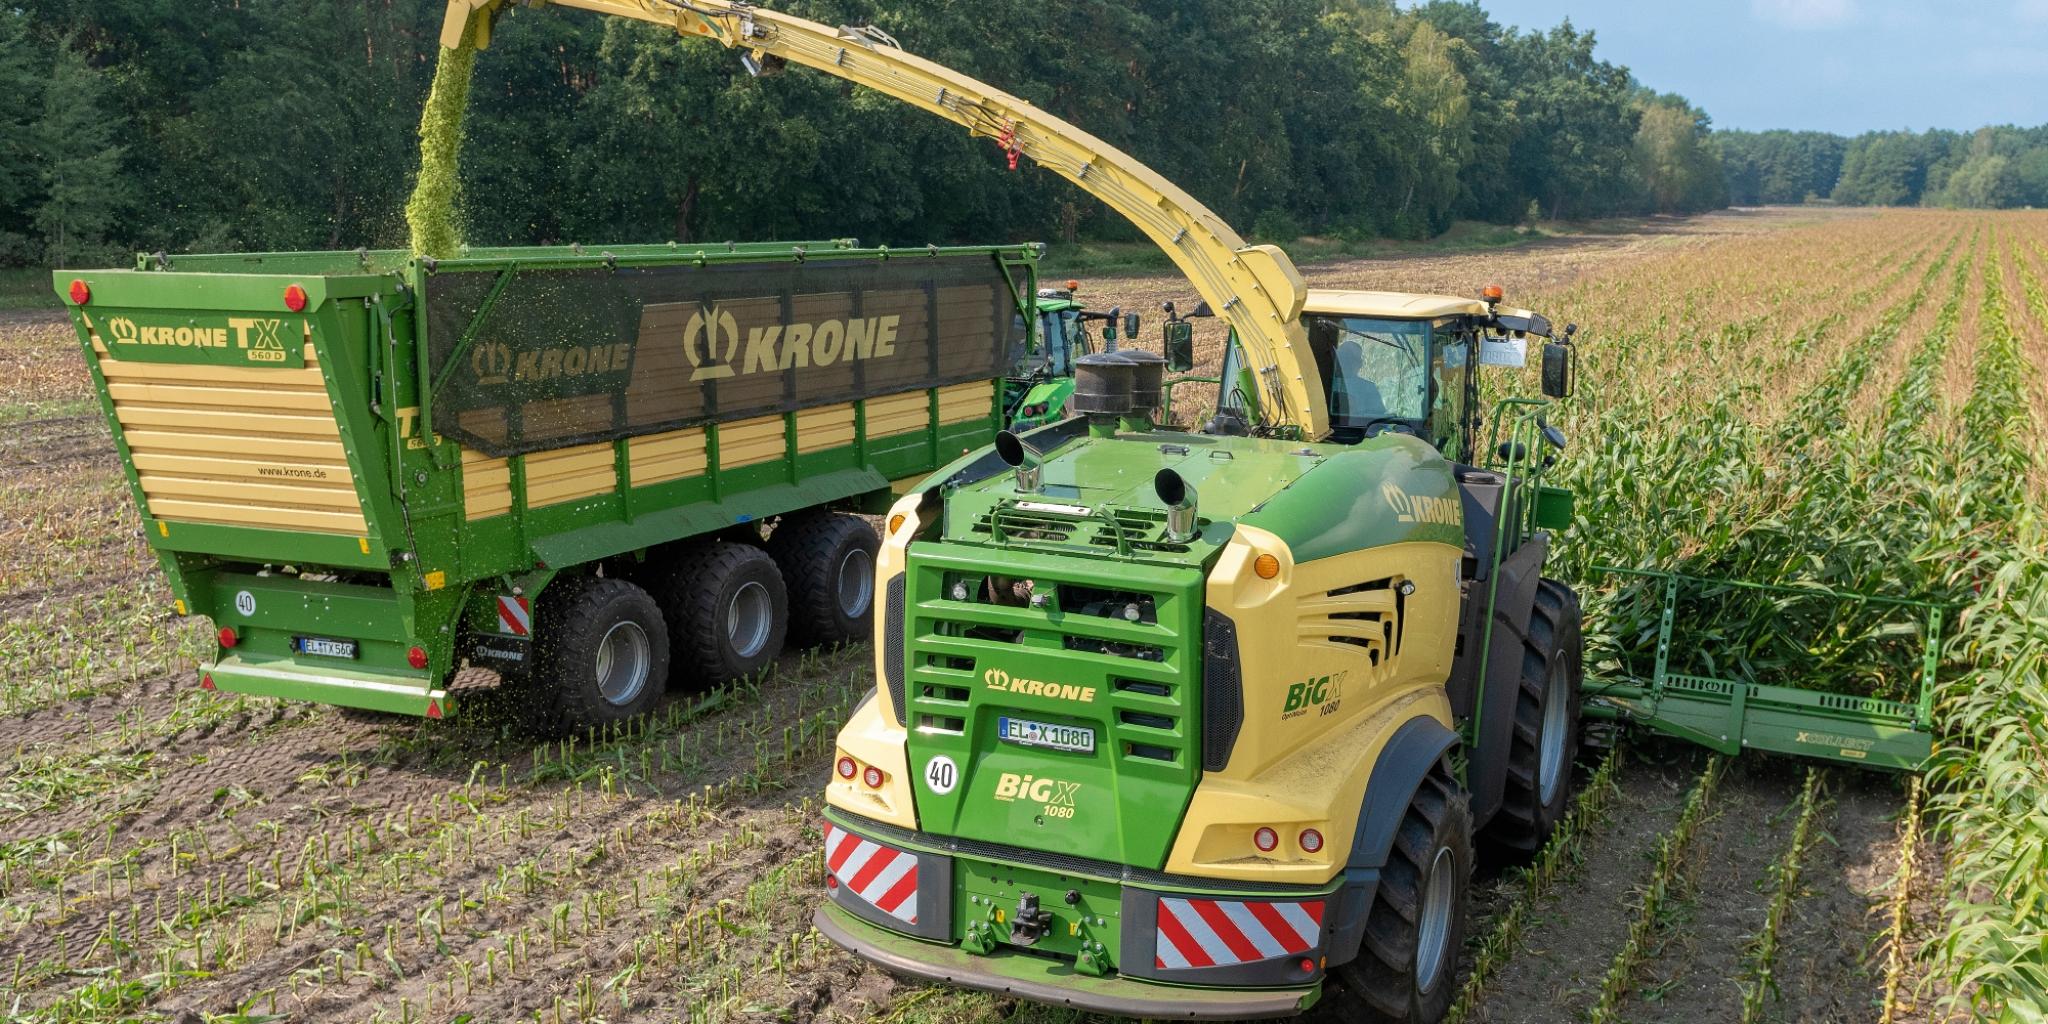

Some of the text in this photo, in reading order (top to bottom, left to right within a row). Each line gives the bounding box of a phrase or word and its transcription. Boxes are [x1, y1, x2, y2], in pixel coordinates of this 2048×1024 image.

[140, 317, 284, 350] KRONE TX
[251, 351, 282, 361] 560 D
[743, 315, 900, 375] KRONE
[516, 343, 632, 381] KRONE
[257, 466, 327, 479] www.krone.de
[1410, 495, 1461, 527] KRONE
[238, 595, 252, 612] 40
[305, 641, 317, 653] EL
[487, 649, 524, 660] KRONE
[1009, 678, 1097, 703] KRONE
[1320, 699, 1341, 718] 1080
[1009, 721, 1091, 748] EL X 1080
[929, 761, 953, 788] 40
[1043, 805, 1075, 819] 1080
